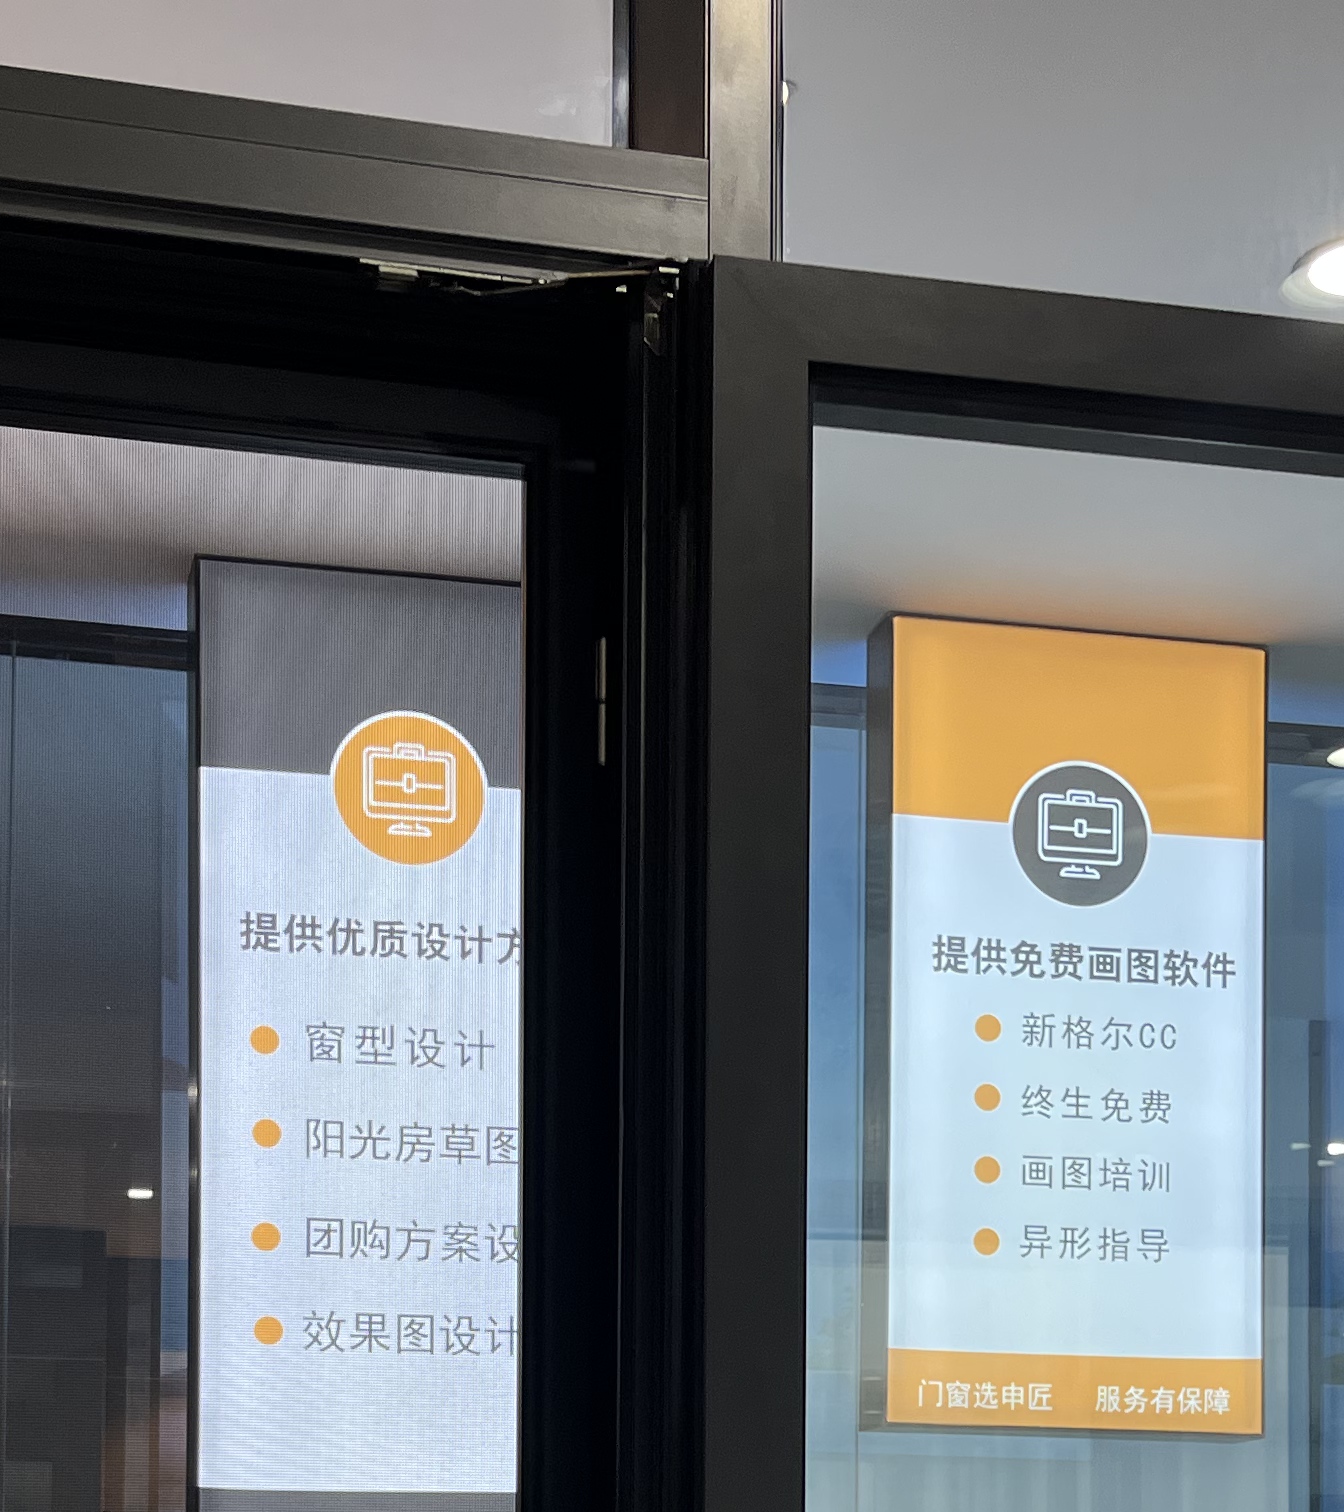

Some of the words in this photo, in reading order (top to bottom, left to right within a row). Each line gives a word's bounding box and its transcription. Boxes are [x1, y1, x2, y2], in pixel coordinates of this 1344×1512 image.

[932, 934, 1236, 989] 提供免费画图软件
[305, 1021, 495, 1070] 窗型设计
[1021, 1012, 1177, 1051] 新格尔CC
[1020, 1085, 1172, 1124] 终生免费
[306, 1119, 519, 1166] 阳光房草图
[1021, 1155, 1171, 1193] 画图培训
[306, 1217, 519, 1263] 团购方案设
[1019, 1225, 1170, 1263] 异形指导
[303, 1310, 518, 1356] 效果图设计
[918, 1380, 1053, 1412] 门窗选申匠
[1095, 1385, 1230, 1415] 服务有保障
